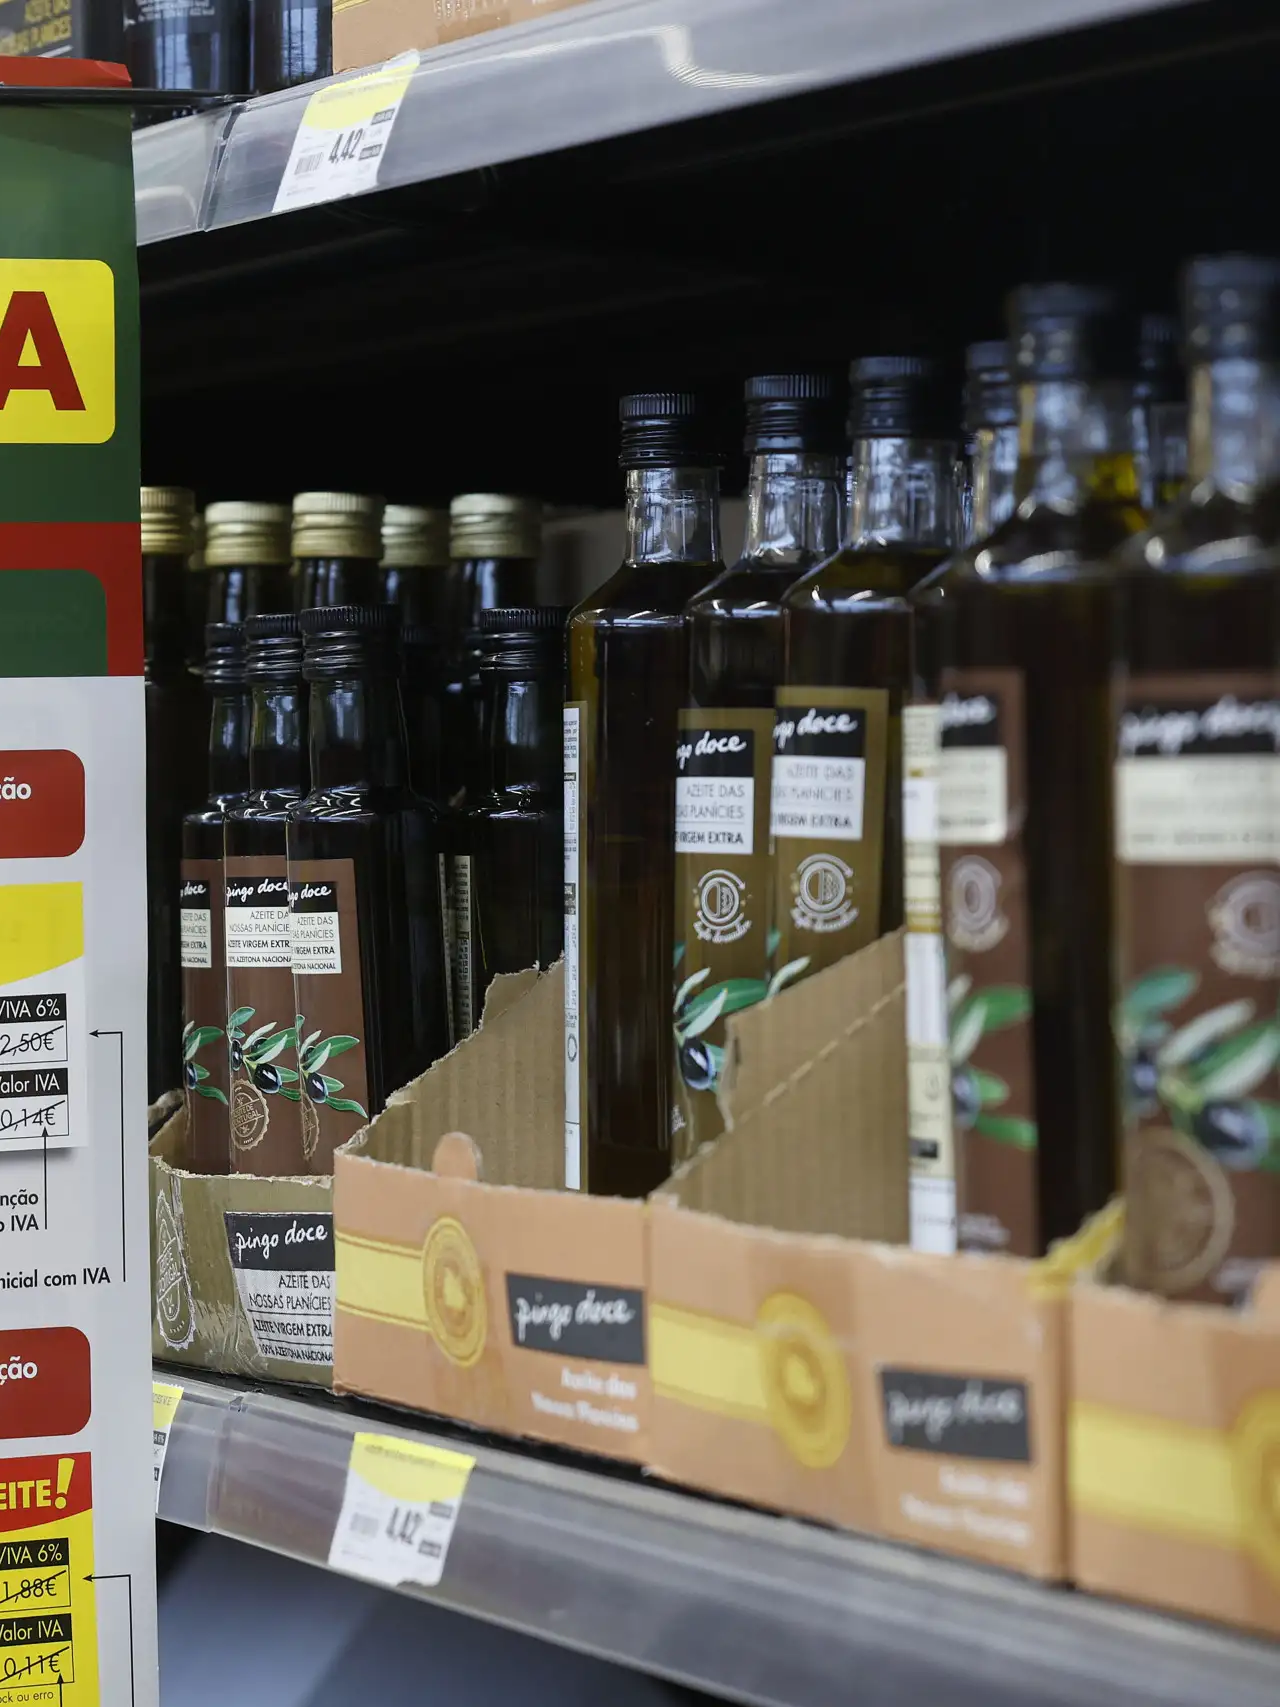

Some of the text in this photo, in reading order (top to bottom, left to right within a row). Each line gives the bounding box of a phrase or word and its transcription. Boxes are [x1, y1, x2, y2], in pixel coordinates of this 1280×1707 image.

[797, 708, 858, 736] doce
[695, 731, 747, 756] doce
[720, 784, 745, 798] DAS
[708, 831, 744, 844] EXTRA
[184, 881, 207, 896] doce
[226, 883, 254, 906] pingo
[300, 883, 332, 900] doce
[250, 911, 289, 920] AZEITE DA
[317, 916, 334, 926] DAS
[254, 921, 290, 932] PLANÍCIE
[242, 940, 268, 948] VIRGEM
[270, 940, 290, 948] EXTR
[313, 946, 335, 954] EXTRA
[36, 998, 60, 1016] 6%
[0, 1033, 55, 1056] 2,50€
[35, 1072, 60, 1091] IVA
[0, 1106, 56, 1131] 0,14€
[10, 1214, 39, 1232] IVA
[235, 1220, 328, 1263] pingo doce
[43, 1272, 77, 1286] com
[82, 1267, 111, 1284] IVA
[278, 1275, 331, 1289] AZEITE DAS
[249, 1293, 332, 1311] NOSSAS PLANÍCIES
[515, 1289, 636, 1342] pingo doce
[274, 1321, 305, 1336] VIRGEM
[37, 1543, 63, 1563] 6%
[3, 1577, 58, 1603] 1,88€
[37, 1619, 64, 1639] IVA
[3, 1653, 61, 1680] 0,11€
[17, 1693, 30, 1702] ou
[33, 1691, 54, 1700] erro
